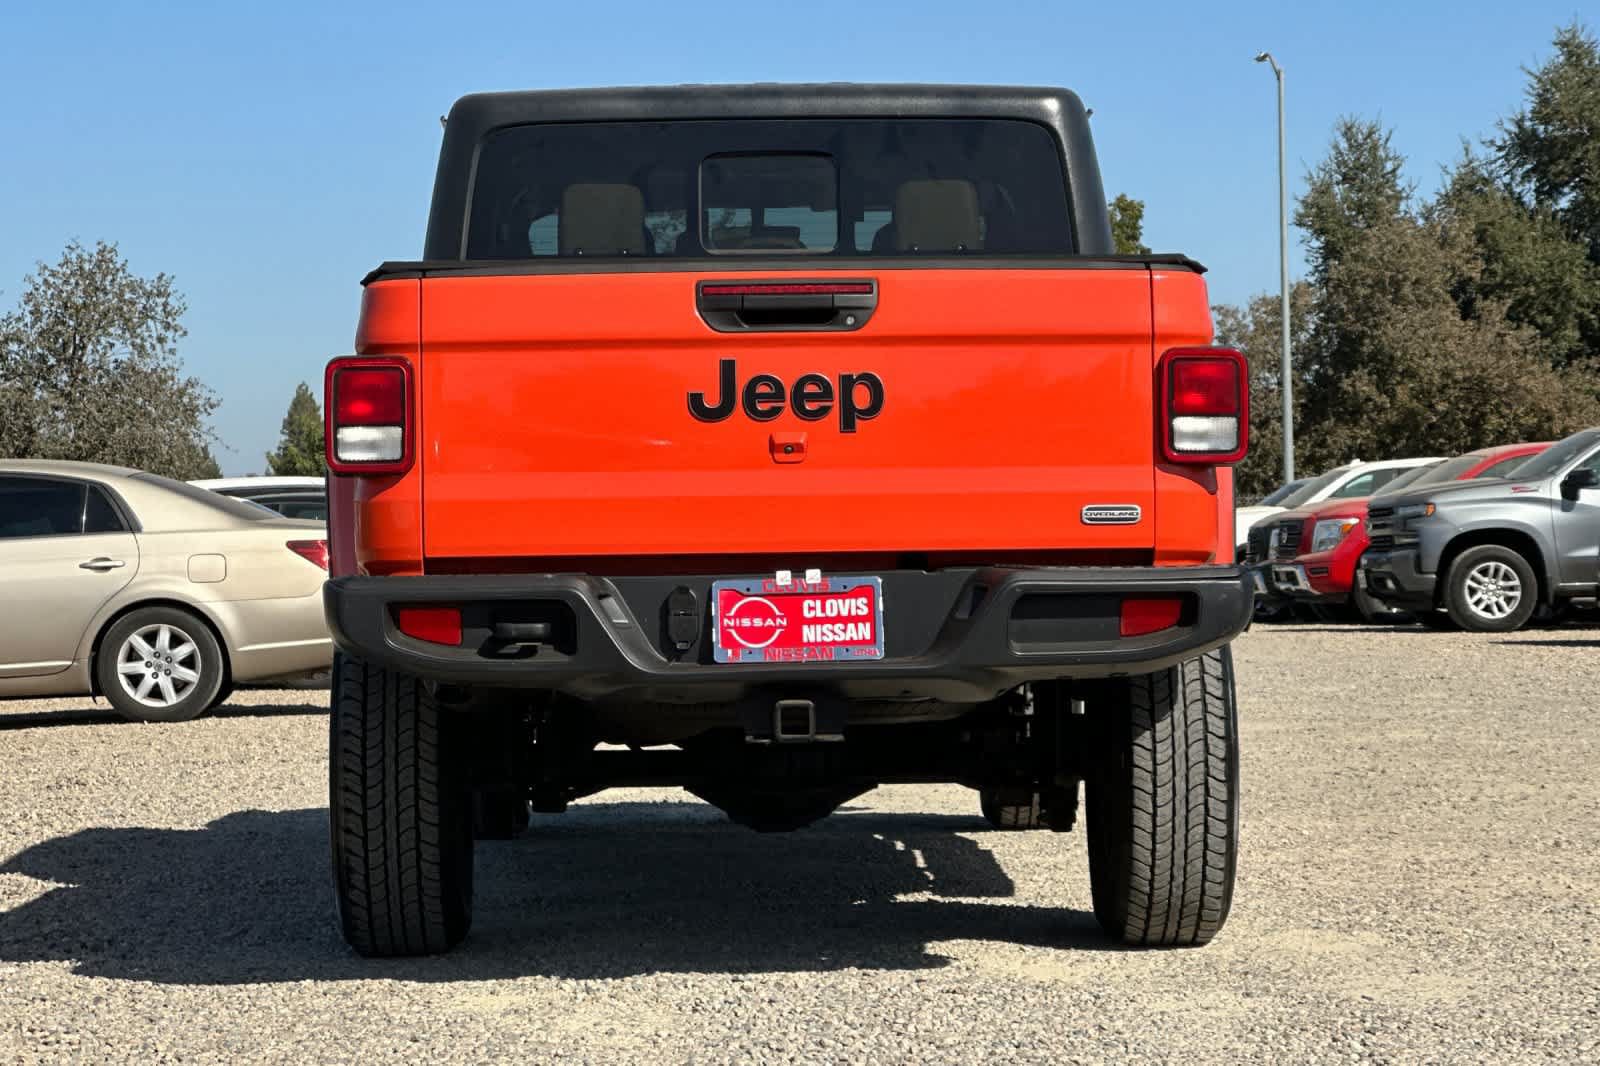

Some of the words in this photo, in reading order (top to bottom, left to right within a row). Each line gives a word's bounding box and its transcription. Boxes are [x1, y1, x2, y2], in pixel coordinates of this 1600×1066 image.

[687, 358, 884, 433] Jeep
[803, 597, 869, 618] CLOVIS
[724, 617, 788, 627] NISSAN
[802, 622, 871, 643] NISSAN
